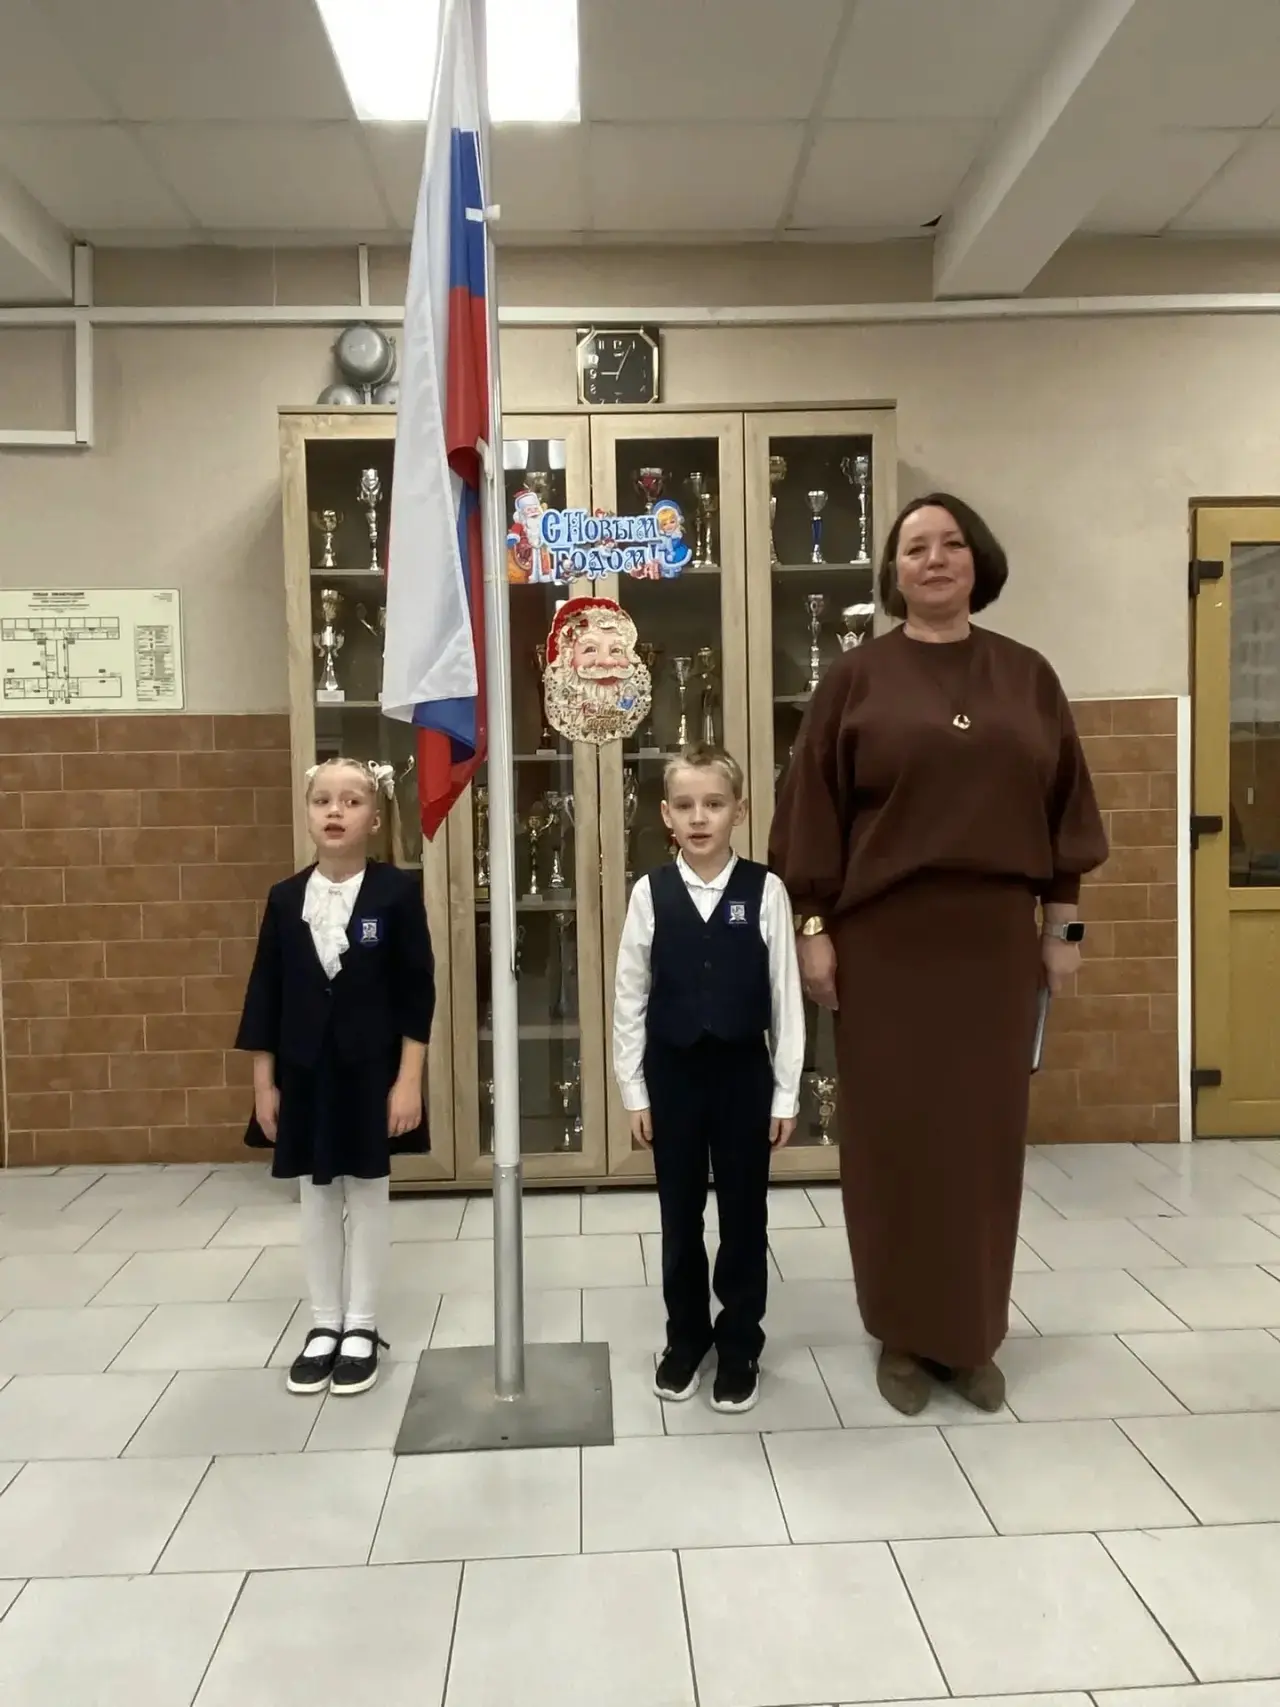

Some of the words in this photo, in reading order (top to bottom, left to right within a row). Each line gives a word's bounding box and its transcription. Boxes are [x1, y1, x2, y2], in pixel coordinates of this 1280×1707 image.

[588, 353, 599, 365] 10
[589, 369, 597, 379] 9
[541, 511, 561, 543] С
[563, 511, 657, 542] Новым
